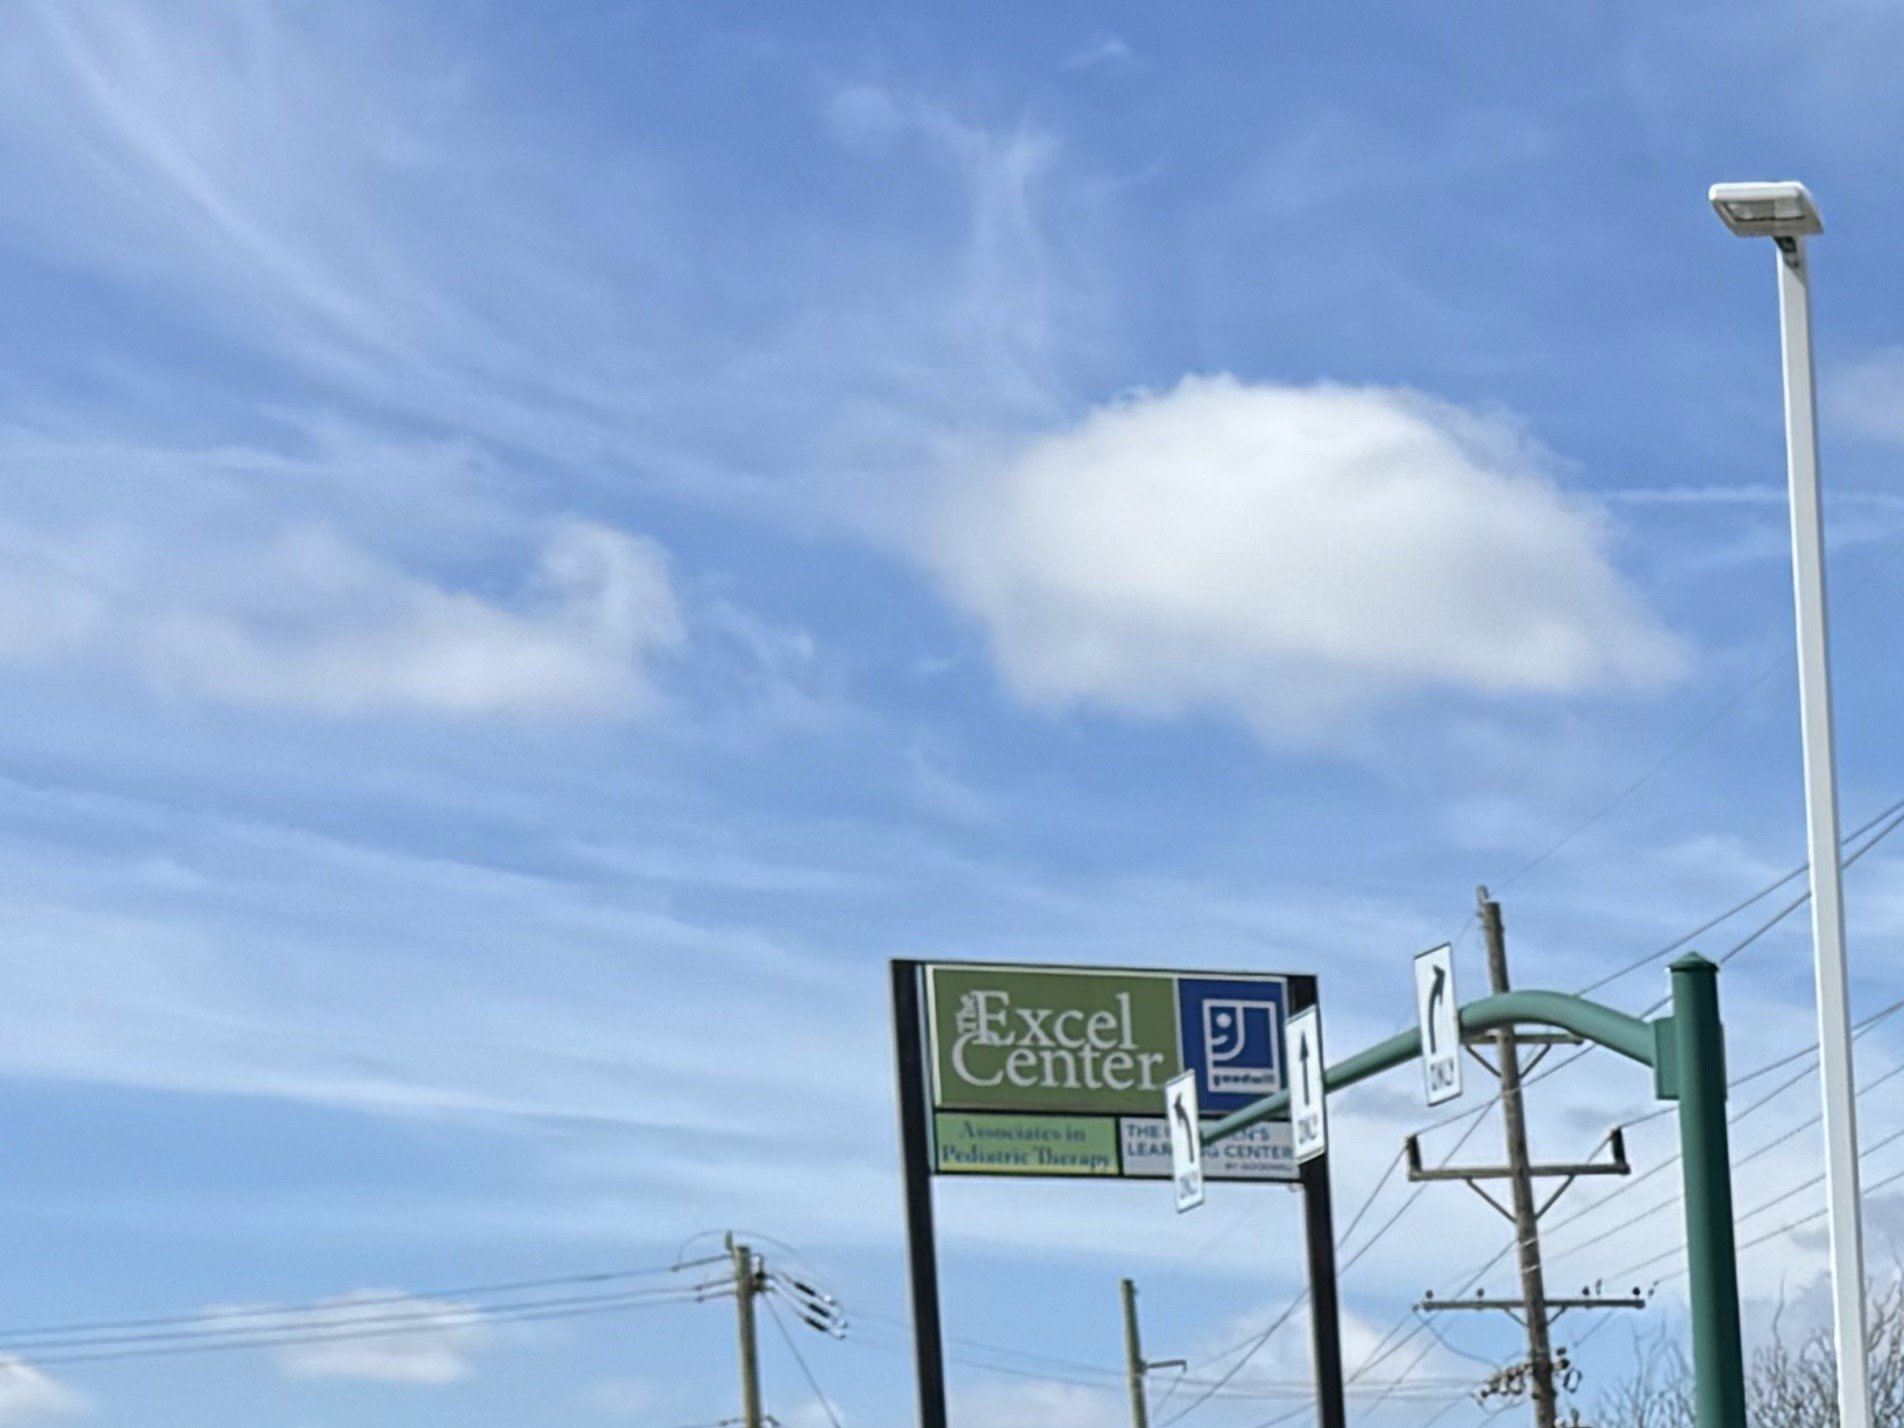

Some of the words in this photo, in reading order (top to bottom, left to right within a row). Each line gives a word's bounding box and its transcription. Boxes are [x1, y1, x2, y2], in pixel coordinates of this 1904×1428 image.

[970, 990, 1138, 1050] Excel
[953, 1029, 1164, 1091] Center
[1212, 1072, 1276, 1087] goodwill
[1223, 1145, 1294, 1160] CENTER
